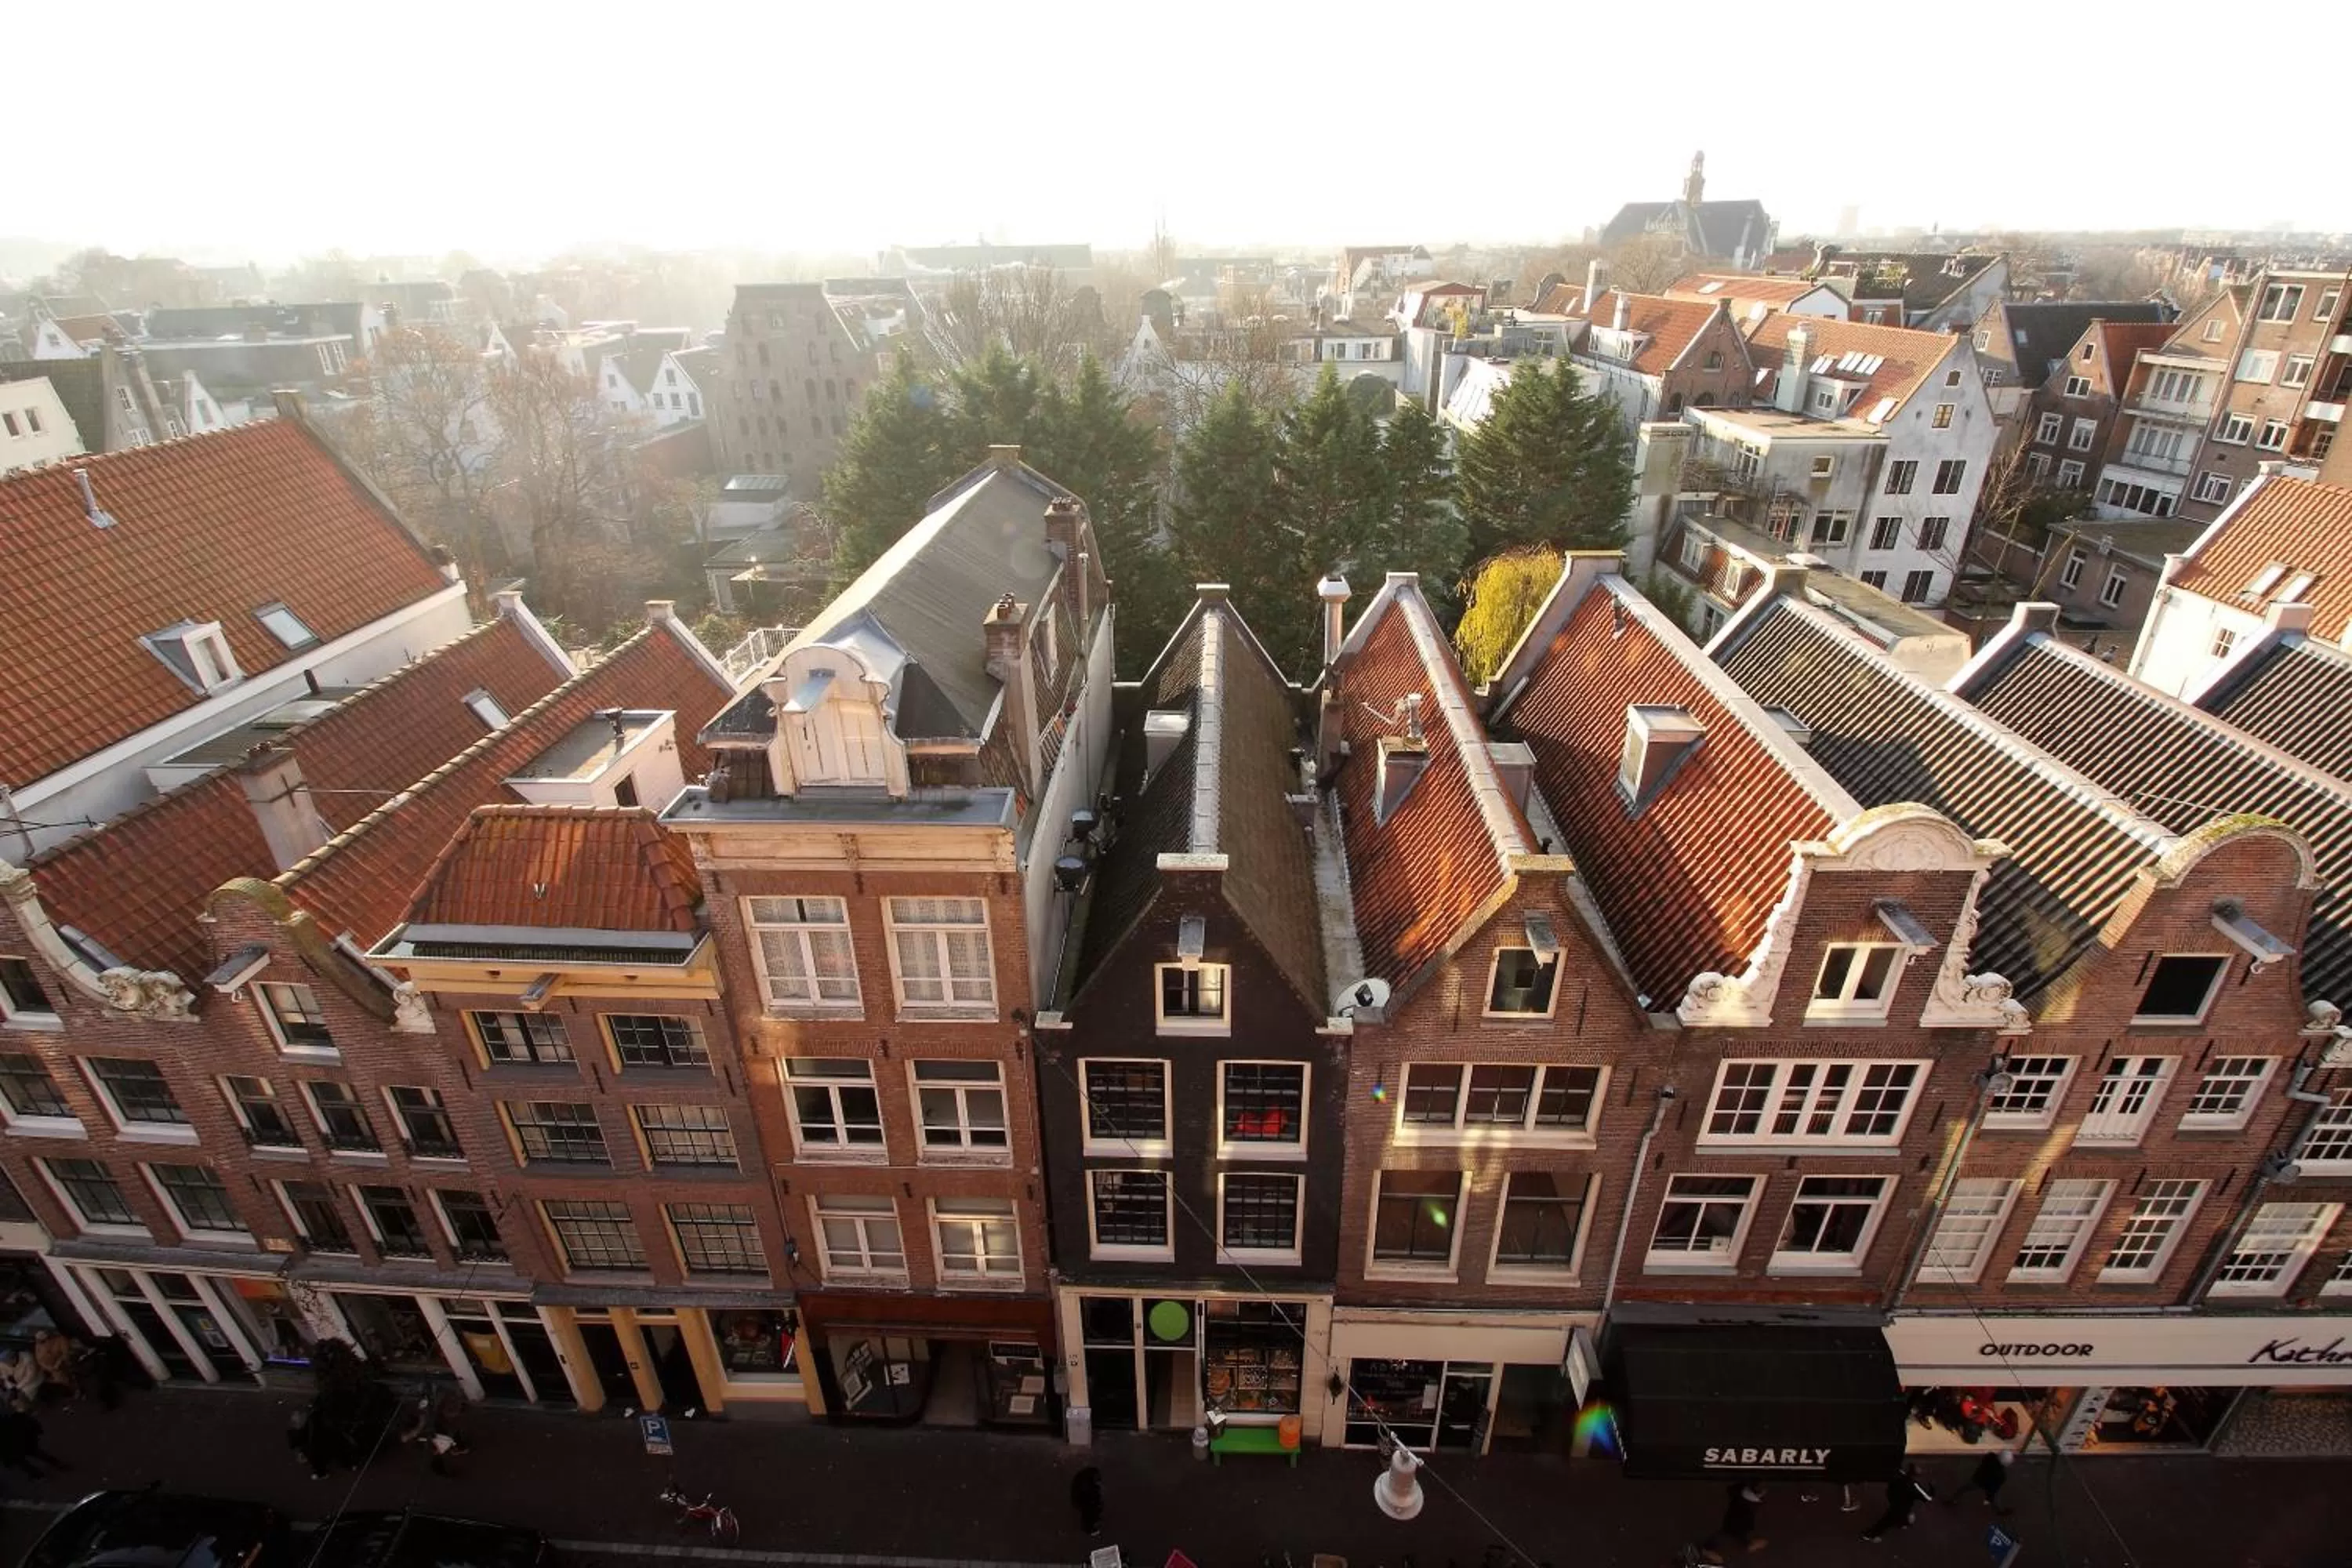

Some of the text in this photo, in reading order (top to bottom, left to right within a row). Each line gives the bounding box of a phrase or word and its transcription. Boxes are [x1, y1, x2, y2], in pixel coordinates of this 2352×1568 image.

[1980, 1343, 2094, 1356] OUTDOOR
[645, 1420, 661, 1434] P
[1703, 1448, 1831, 1465] SABARLY
